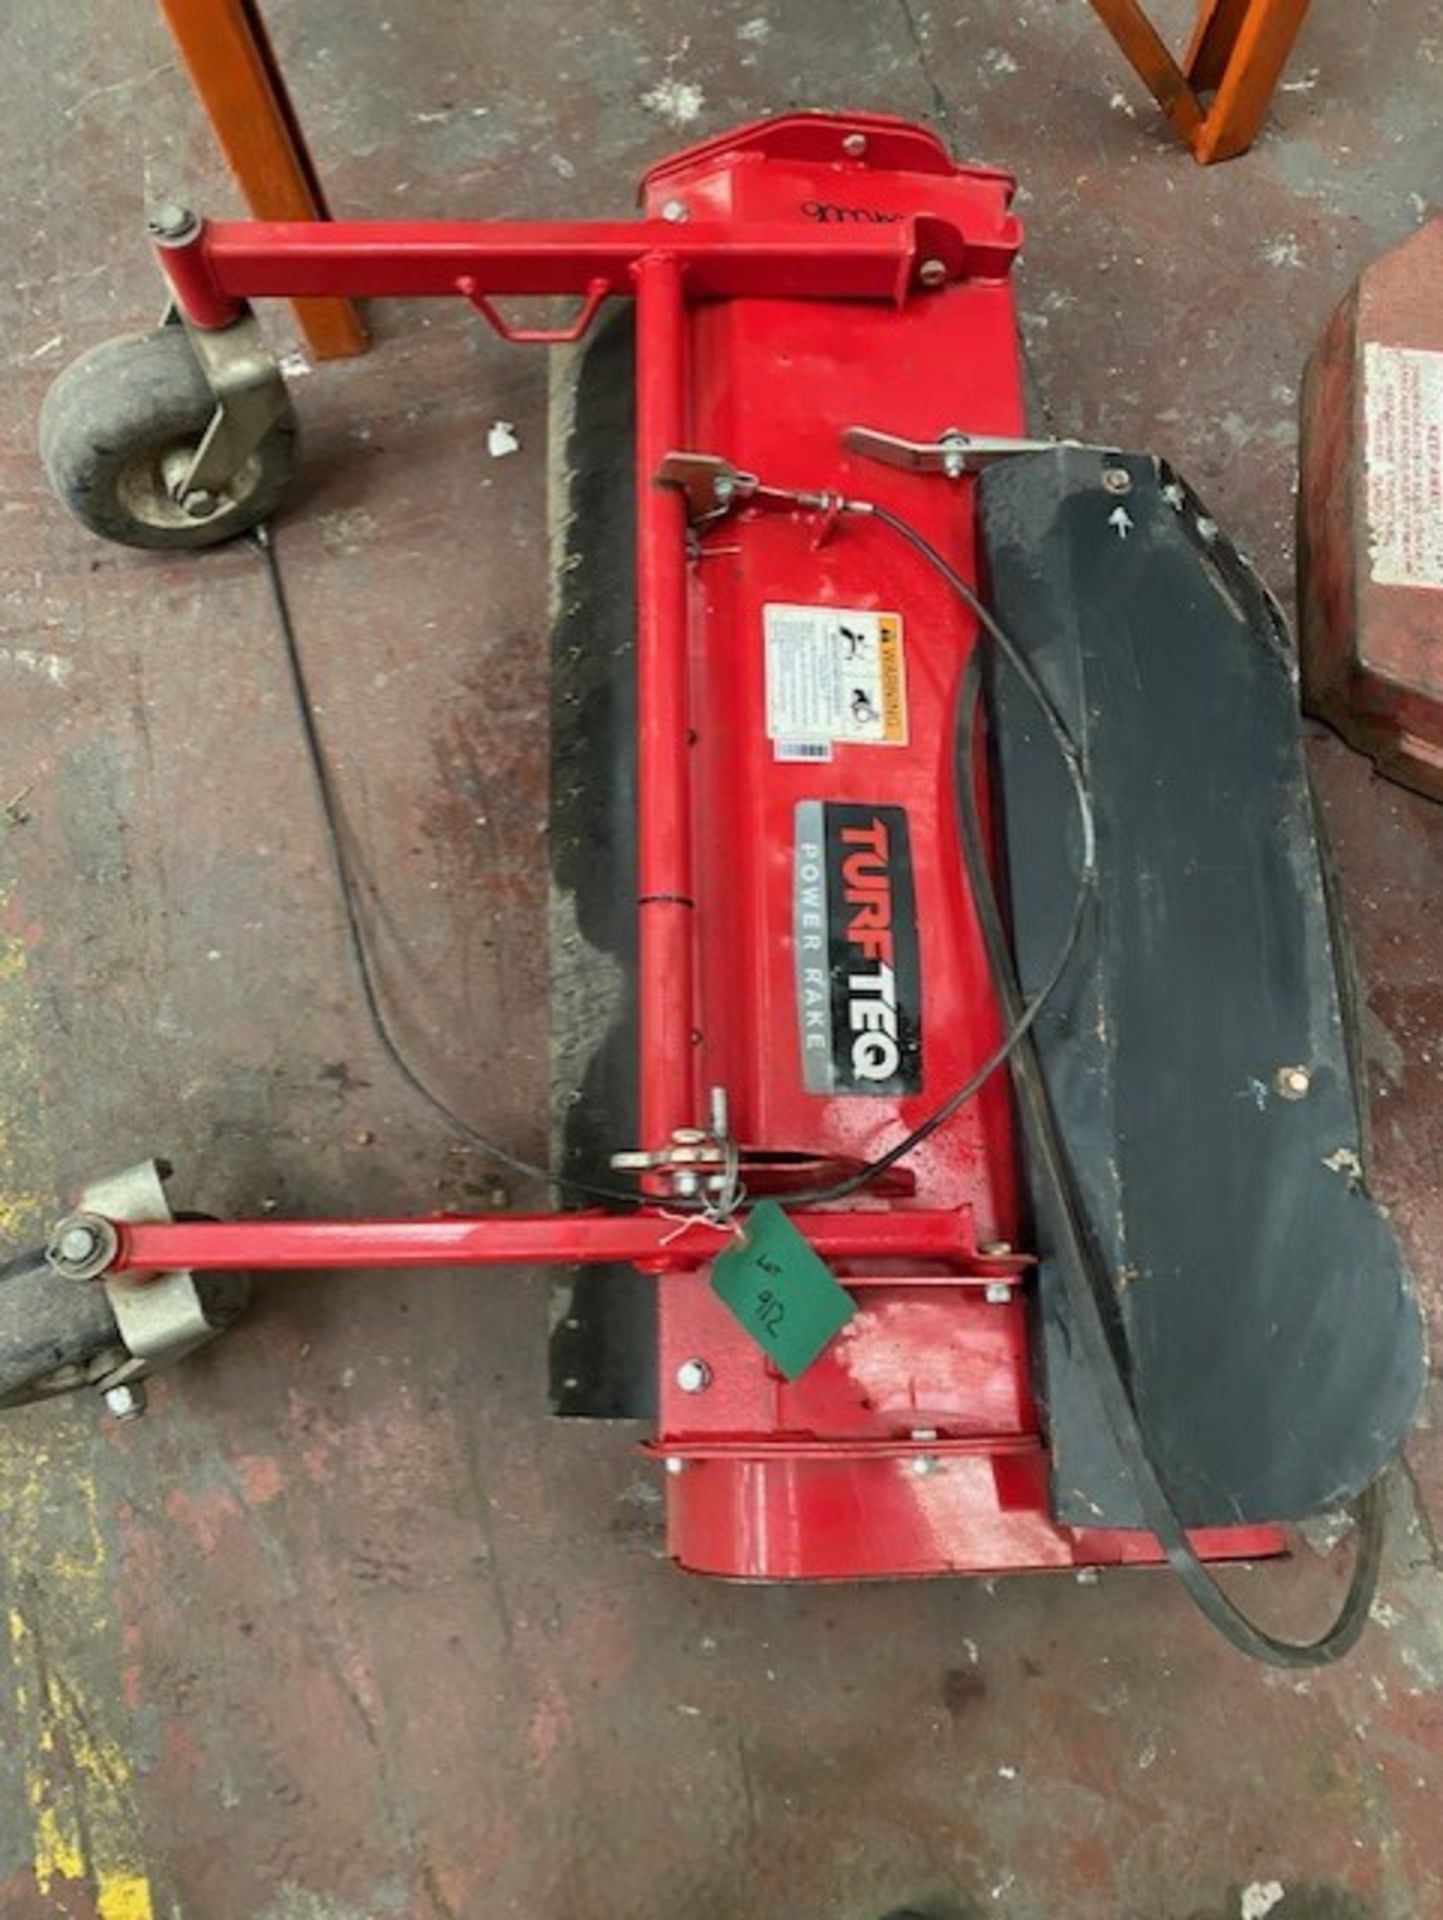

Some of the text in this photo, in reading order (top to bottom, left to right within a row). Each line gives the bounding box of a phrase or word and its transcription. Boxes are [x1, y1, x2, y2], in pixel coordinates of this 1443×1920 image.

[1428, 425, 1441, 463] KEEP
[883, 648, 901, 727] WARNING
[801, 843, 826, 1049] POWER RAKE
[841, 817, 899, 1080] TURFTEQ
[756, 1290, 785, 1338] 912
